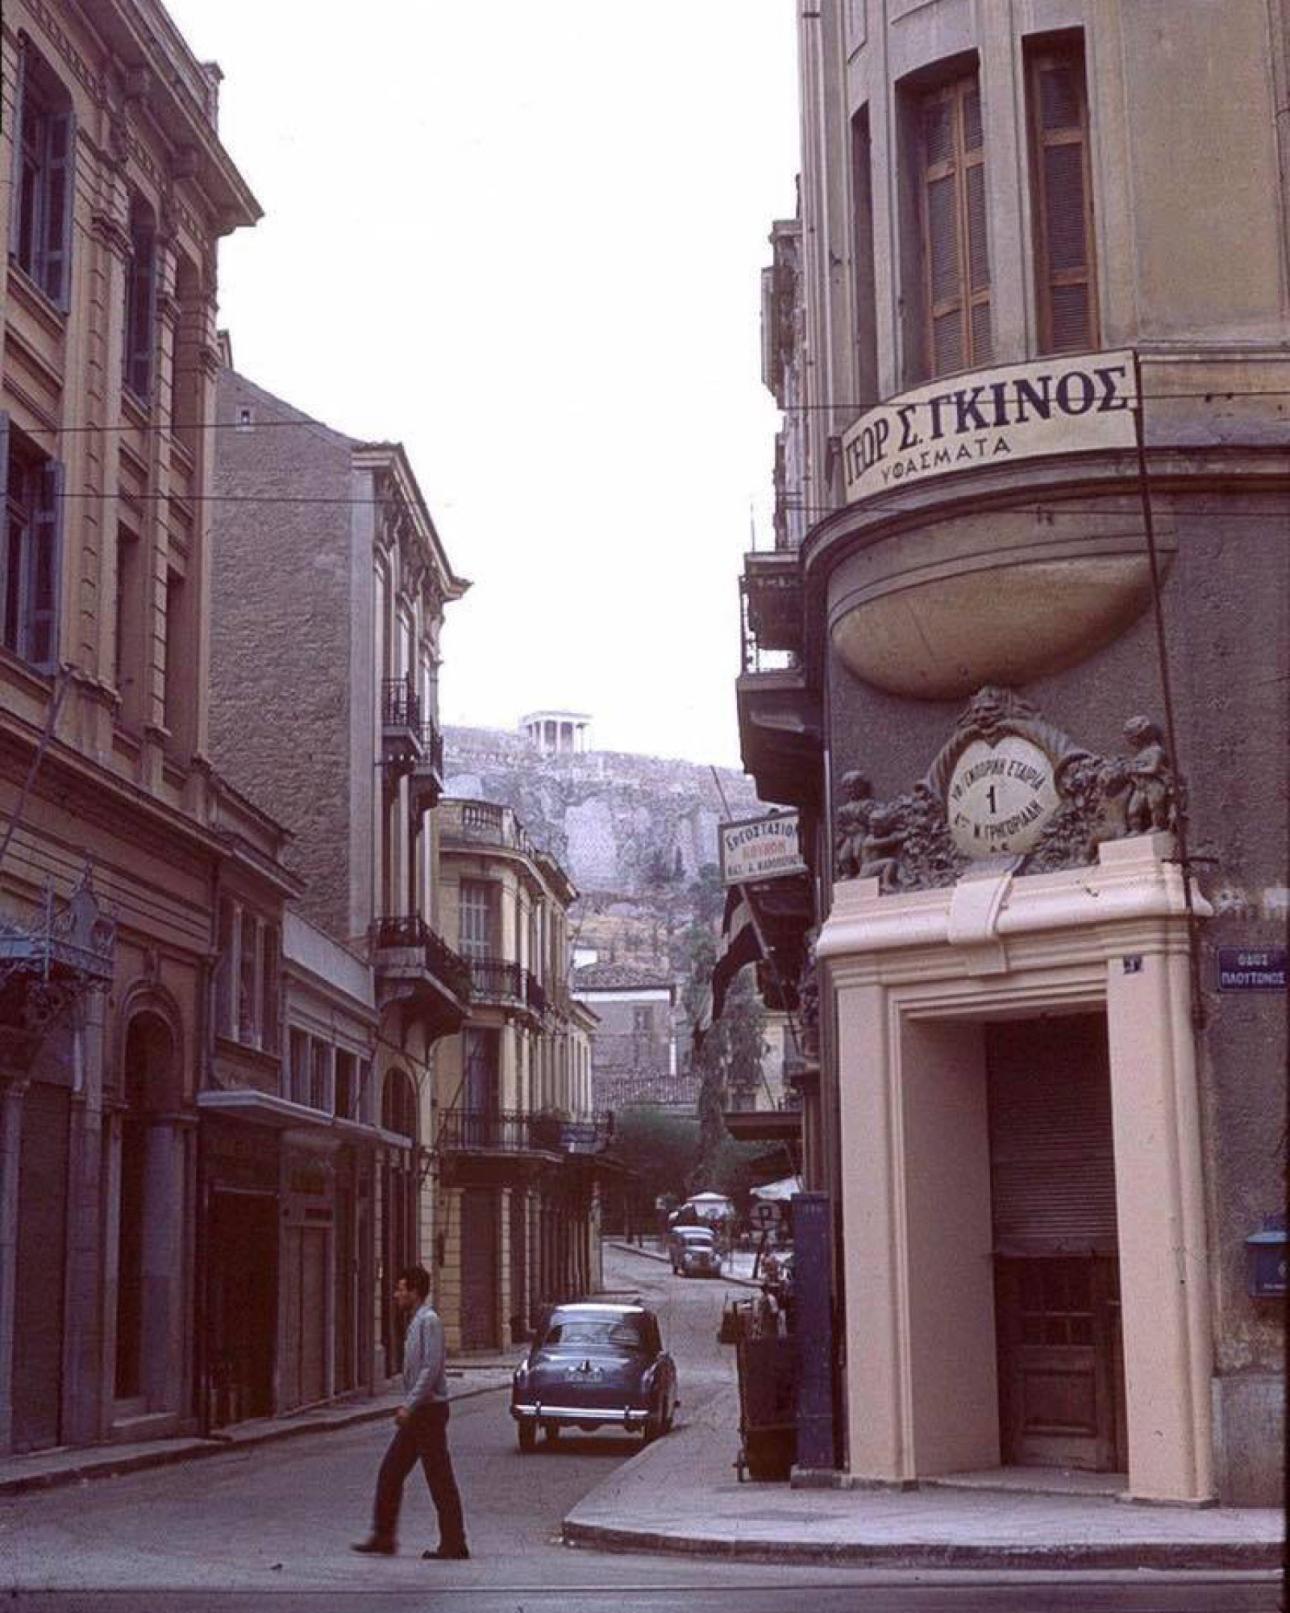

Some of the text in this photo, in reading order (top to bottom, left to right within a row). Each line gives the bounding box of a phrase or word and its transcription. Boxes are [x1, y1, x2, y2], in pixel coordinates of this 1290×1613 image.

[929, 365, 1129, 440] ΓΚΙΝΟΣ
[881, 436, 1012, 484] ΥΦΑΣΜΑΤΑ
[986, 785, 996, 814] 1
